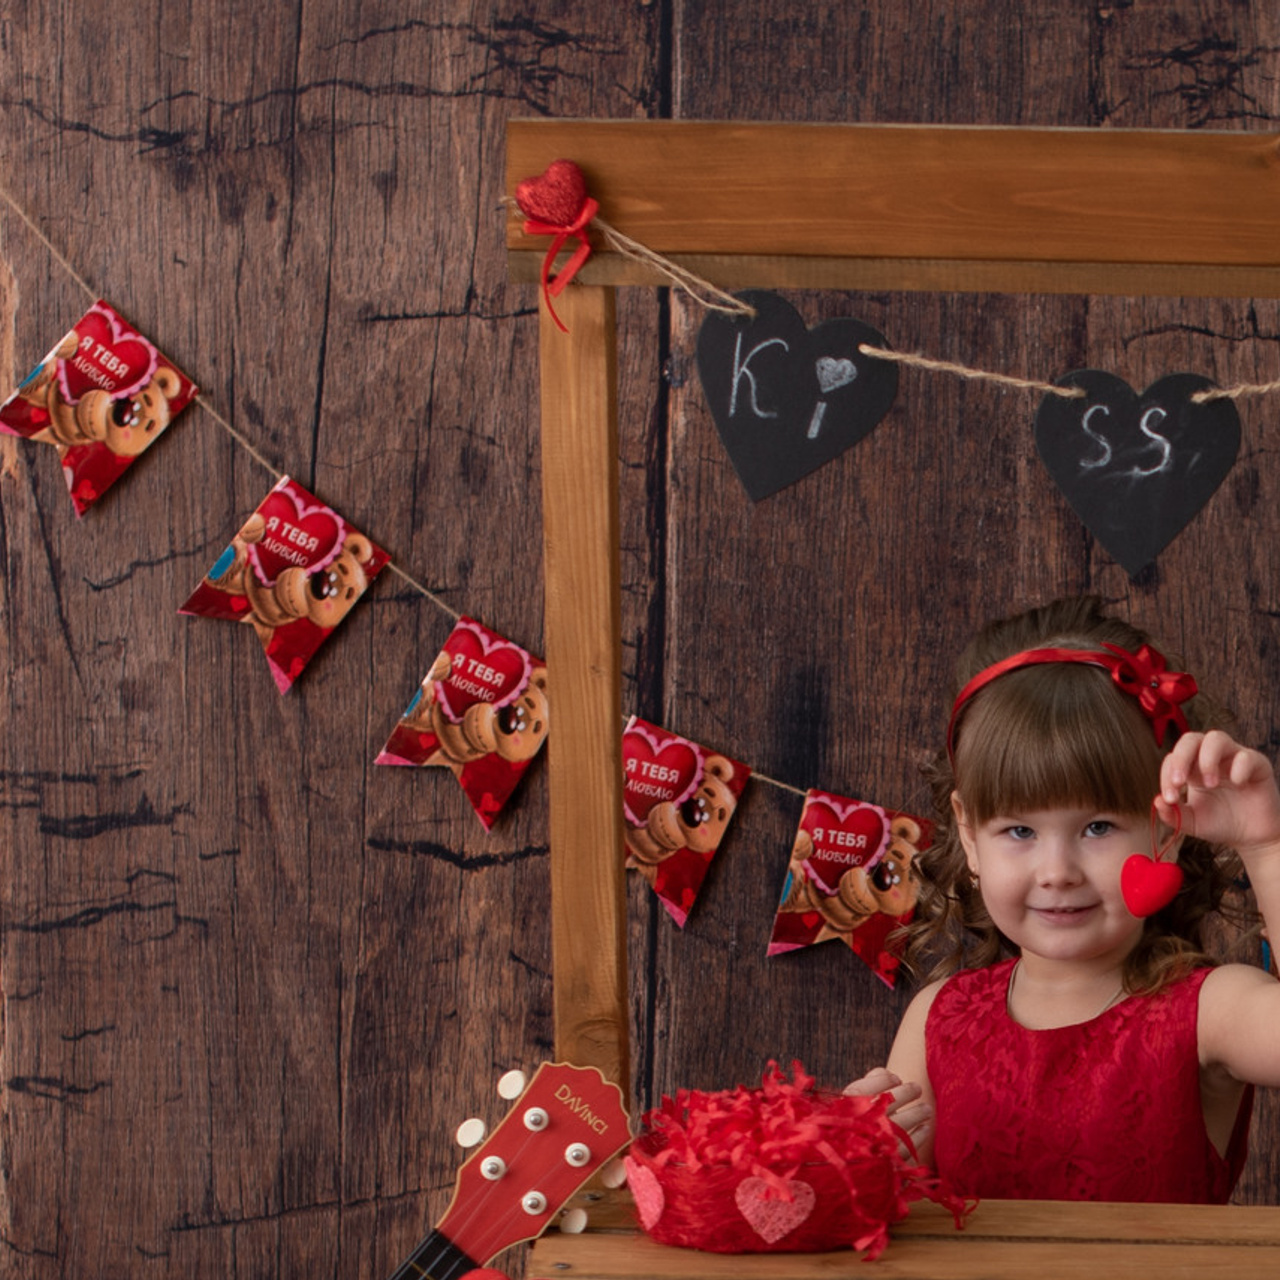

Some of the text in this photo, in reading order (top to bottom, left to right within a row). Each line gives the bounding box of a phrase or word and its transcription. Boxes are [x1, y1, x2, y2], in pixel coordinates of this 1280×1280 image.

[79, 336, 130, 379] Я ТЕБЯ
[72, 355, 116, 391] ЛЮБЛЮ
[266, 516, 319, 552] Я ТЕБЯ
[261, 537, 309, 566] ЛЮБЛЮ
[452, 653, 505, 687] Я ТЕБЯ
[448, 674, 496, 702] ЛЮБЛЮ
[625, 758, 680, 784] Я ТЕБЯ
[625, 779, 674, 800] ЛЮБЛЮ
[812, 827, 868, 849] Я ТЕБЯ
[813, 848, 863, 866] ЛЮБЛЮ
